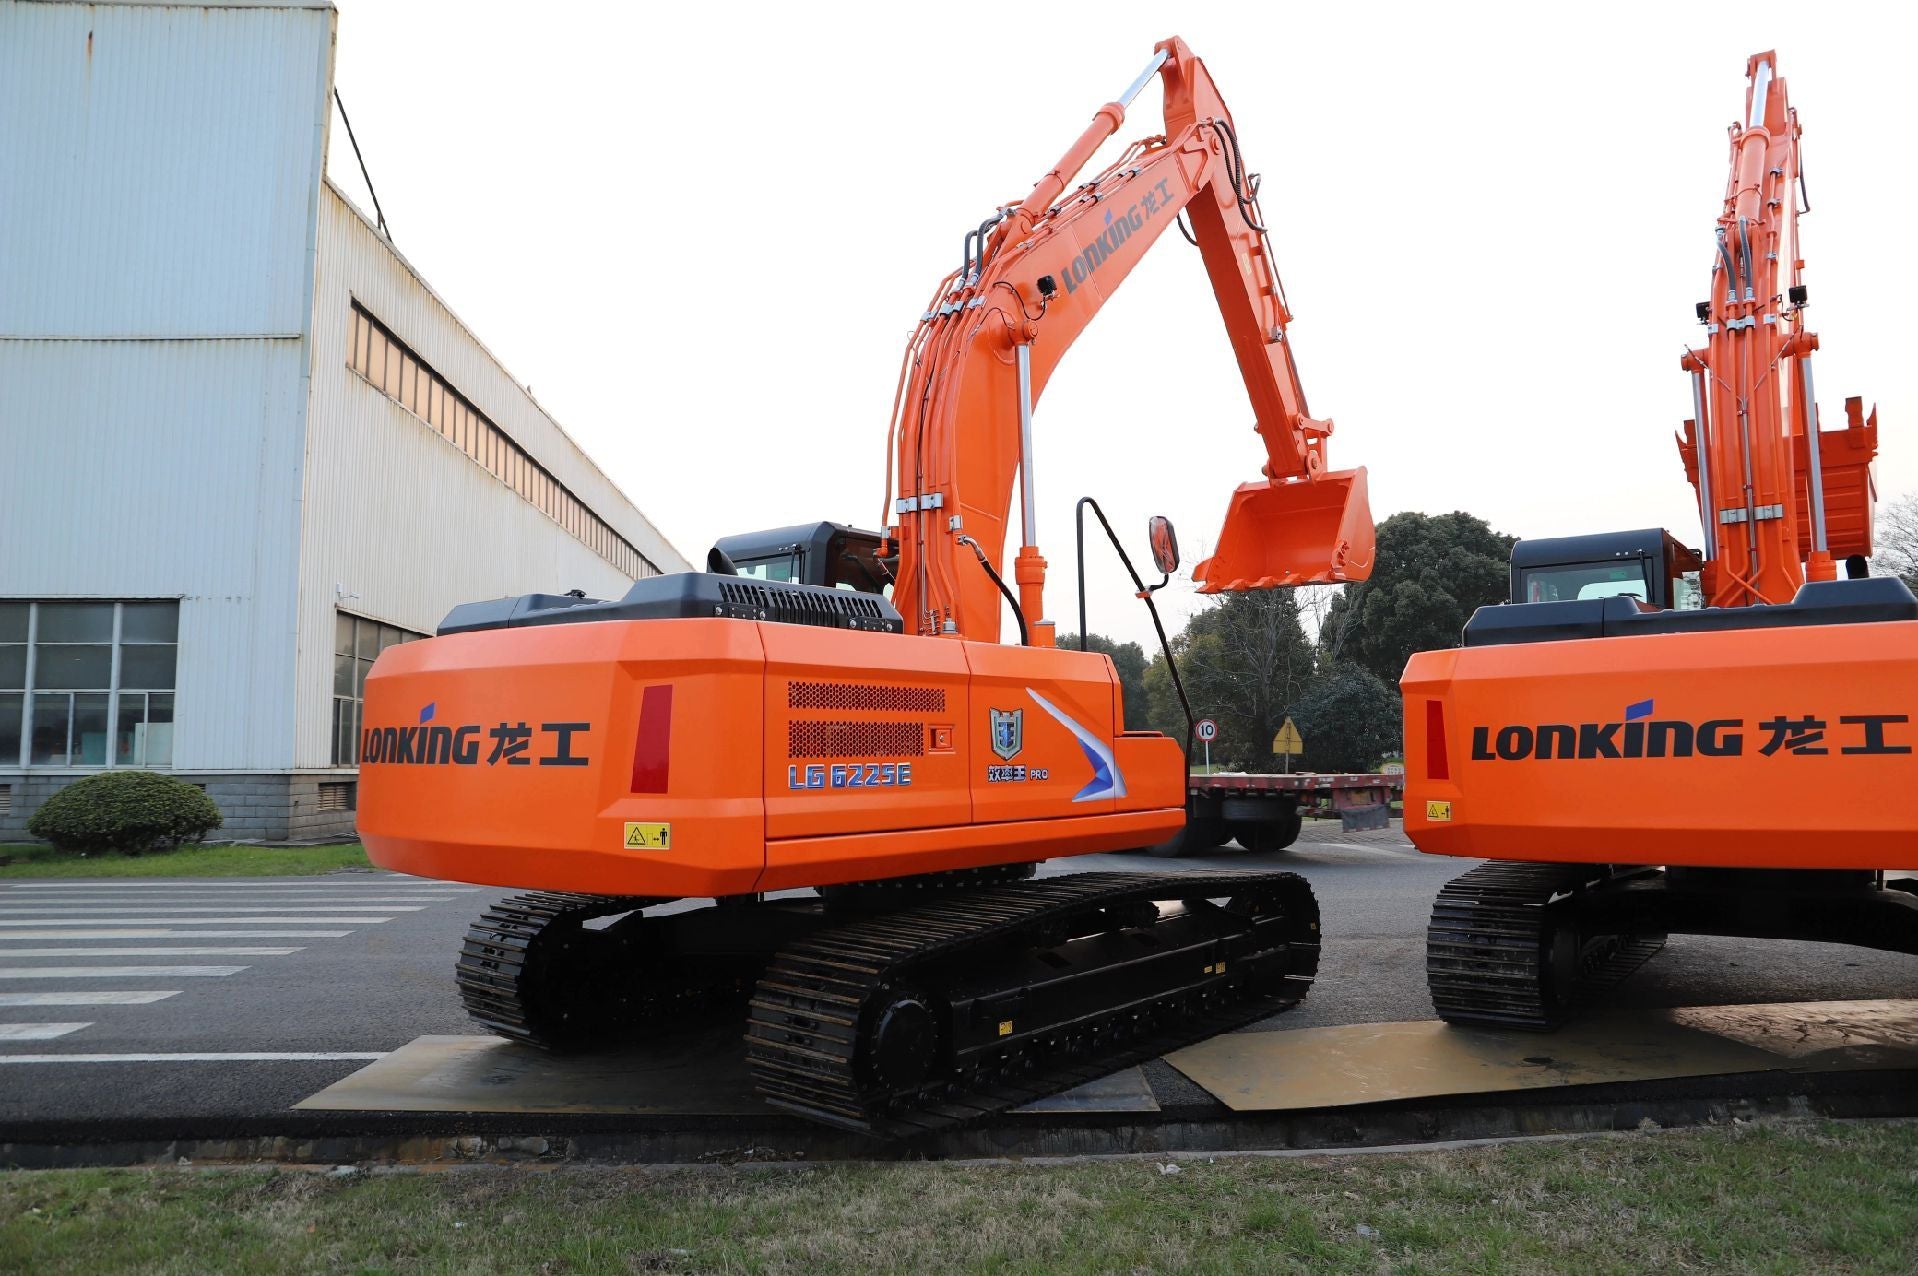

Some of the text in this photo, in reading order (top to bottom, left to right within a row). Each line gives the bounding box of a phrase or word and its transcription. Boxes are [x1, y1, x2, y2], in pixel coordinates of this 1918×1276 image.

[1061, 177, 1174, 294] LONKING 龙工
[362, 702, 591, 766] LONKING 龙工
[1201, 725, 1214, 736] 10
[1471, 698, 1912, 761] LONKING 龙工
[788, 762, 911, 789] LG 6225E
[1030, 768, 1048, 780] PRO
